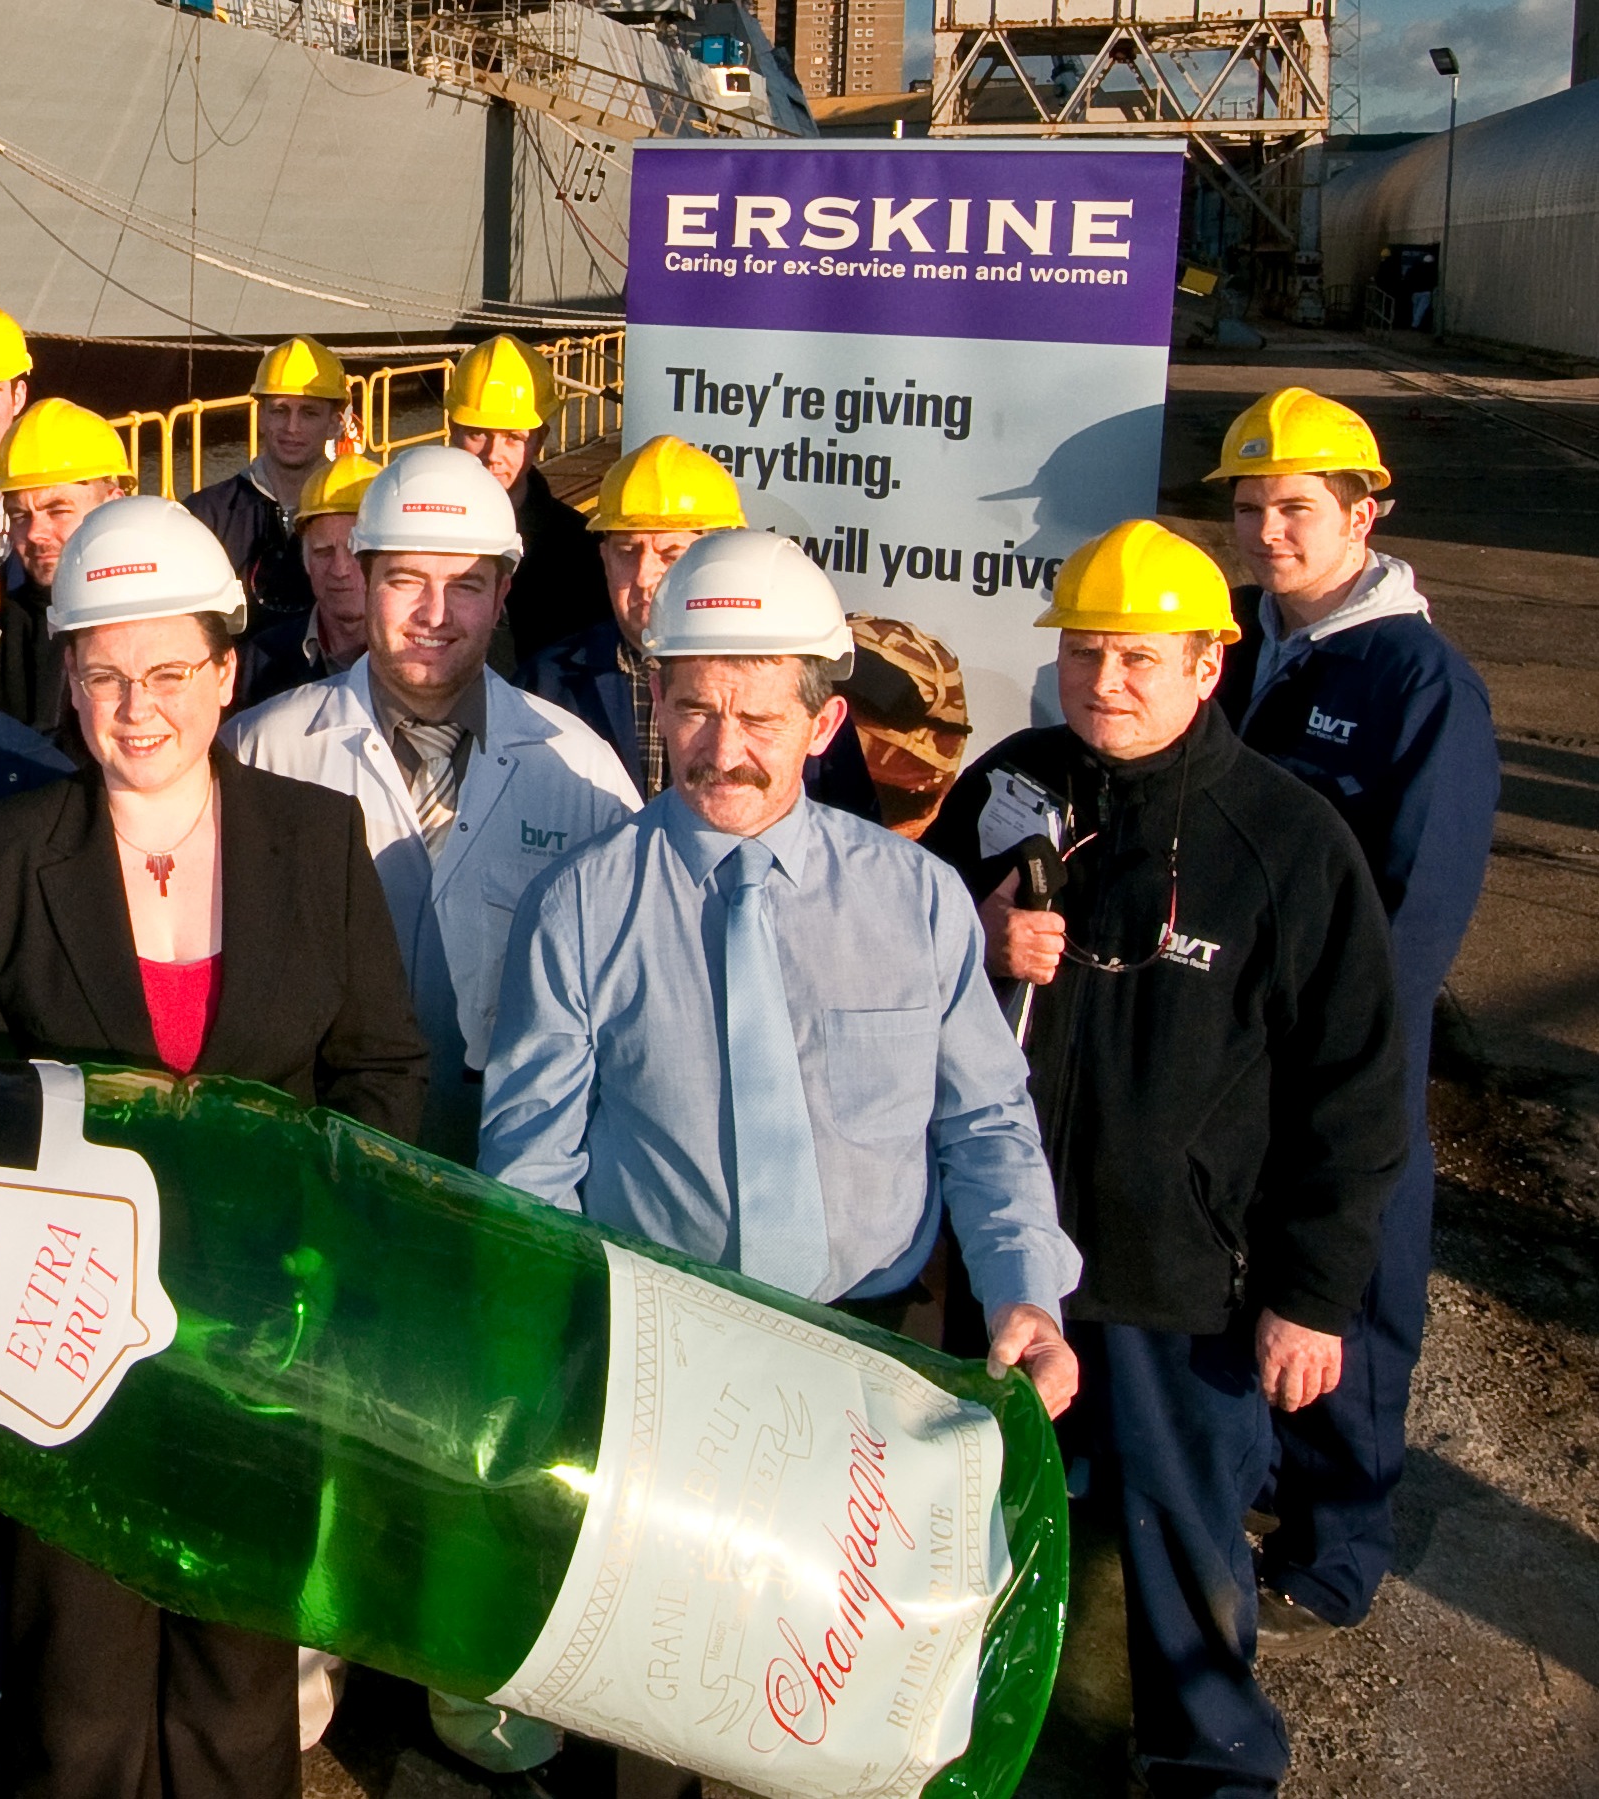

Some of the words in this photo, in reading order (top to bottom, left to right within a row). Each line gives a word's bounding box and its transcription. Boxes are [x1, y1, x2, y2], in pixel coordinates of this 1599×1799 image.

[664, 193, 1134, 260] ERSKINE
[665, 252, 738, 277] Caring
[744, 254, 777, 274] for
[783, 256, 906, 279] ex-Service
[913, 263, 967, 280] men
[975, 262, 1023, 282] and
[1030, 267, 1129, 285] women
[665, 367, 825, 428] They're
[835, 376, 972, 440] giving
[688, 436, 901, 499] erything.
[879, 542, 962, 588] you
[5, 1223, 82, 1372] EXTRA
[54, 1247, 119, 1385] BRUT
[646, 1579, 690, 1701] GRAND
[682, 1382, 751, 1503] BRUT
[747, 1409, 915, 1753] Champagne
[886, 1640, 938, 1731] REIMS
[928, 1503, 954, 1600] RANCE
